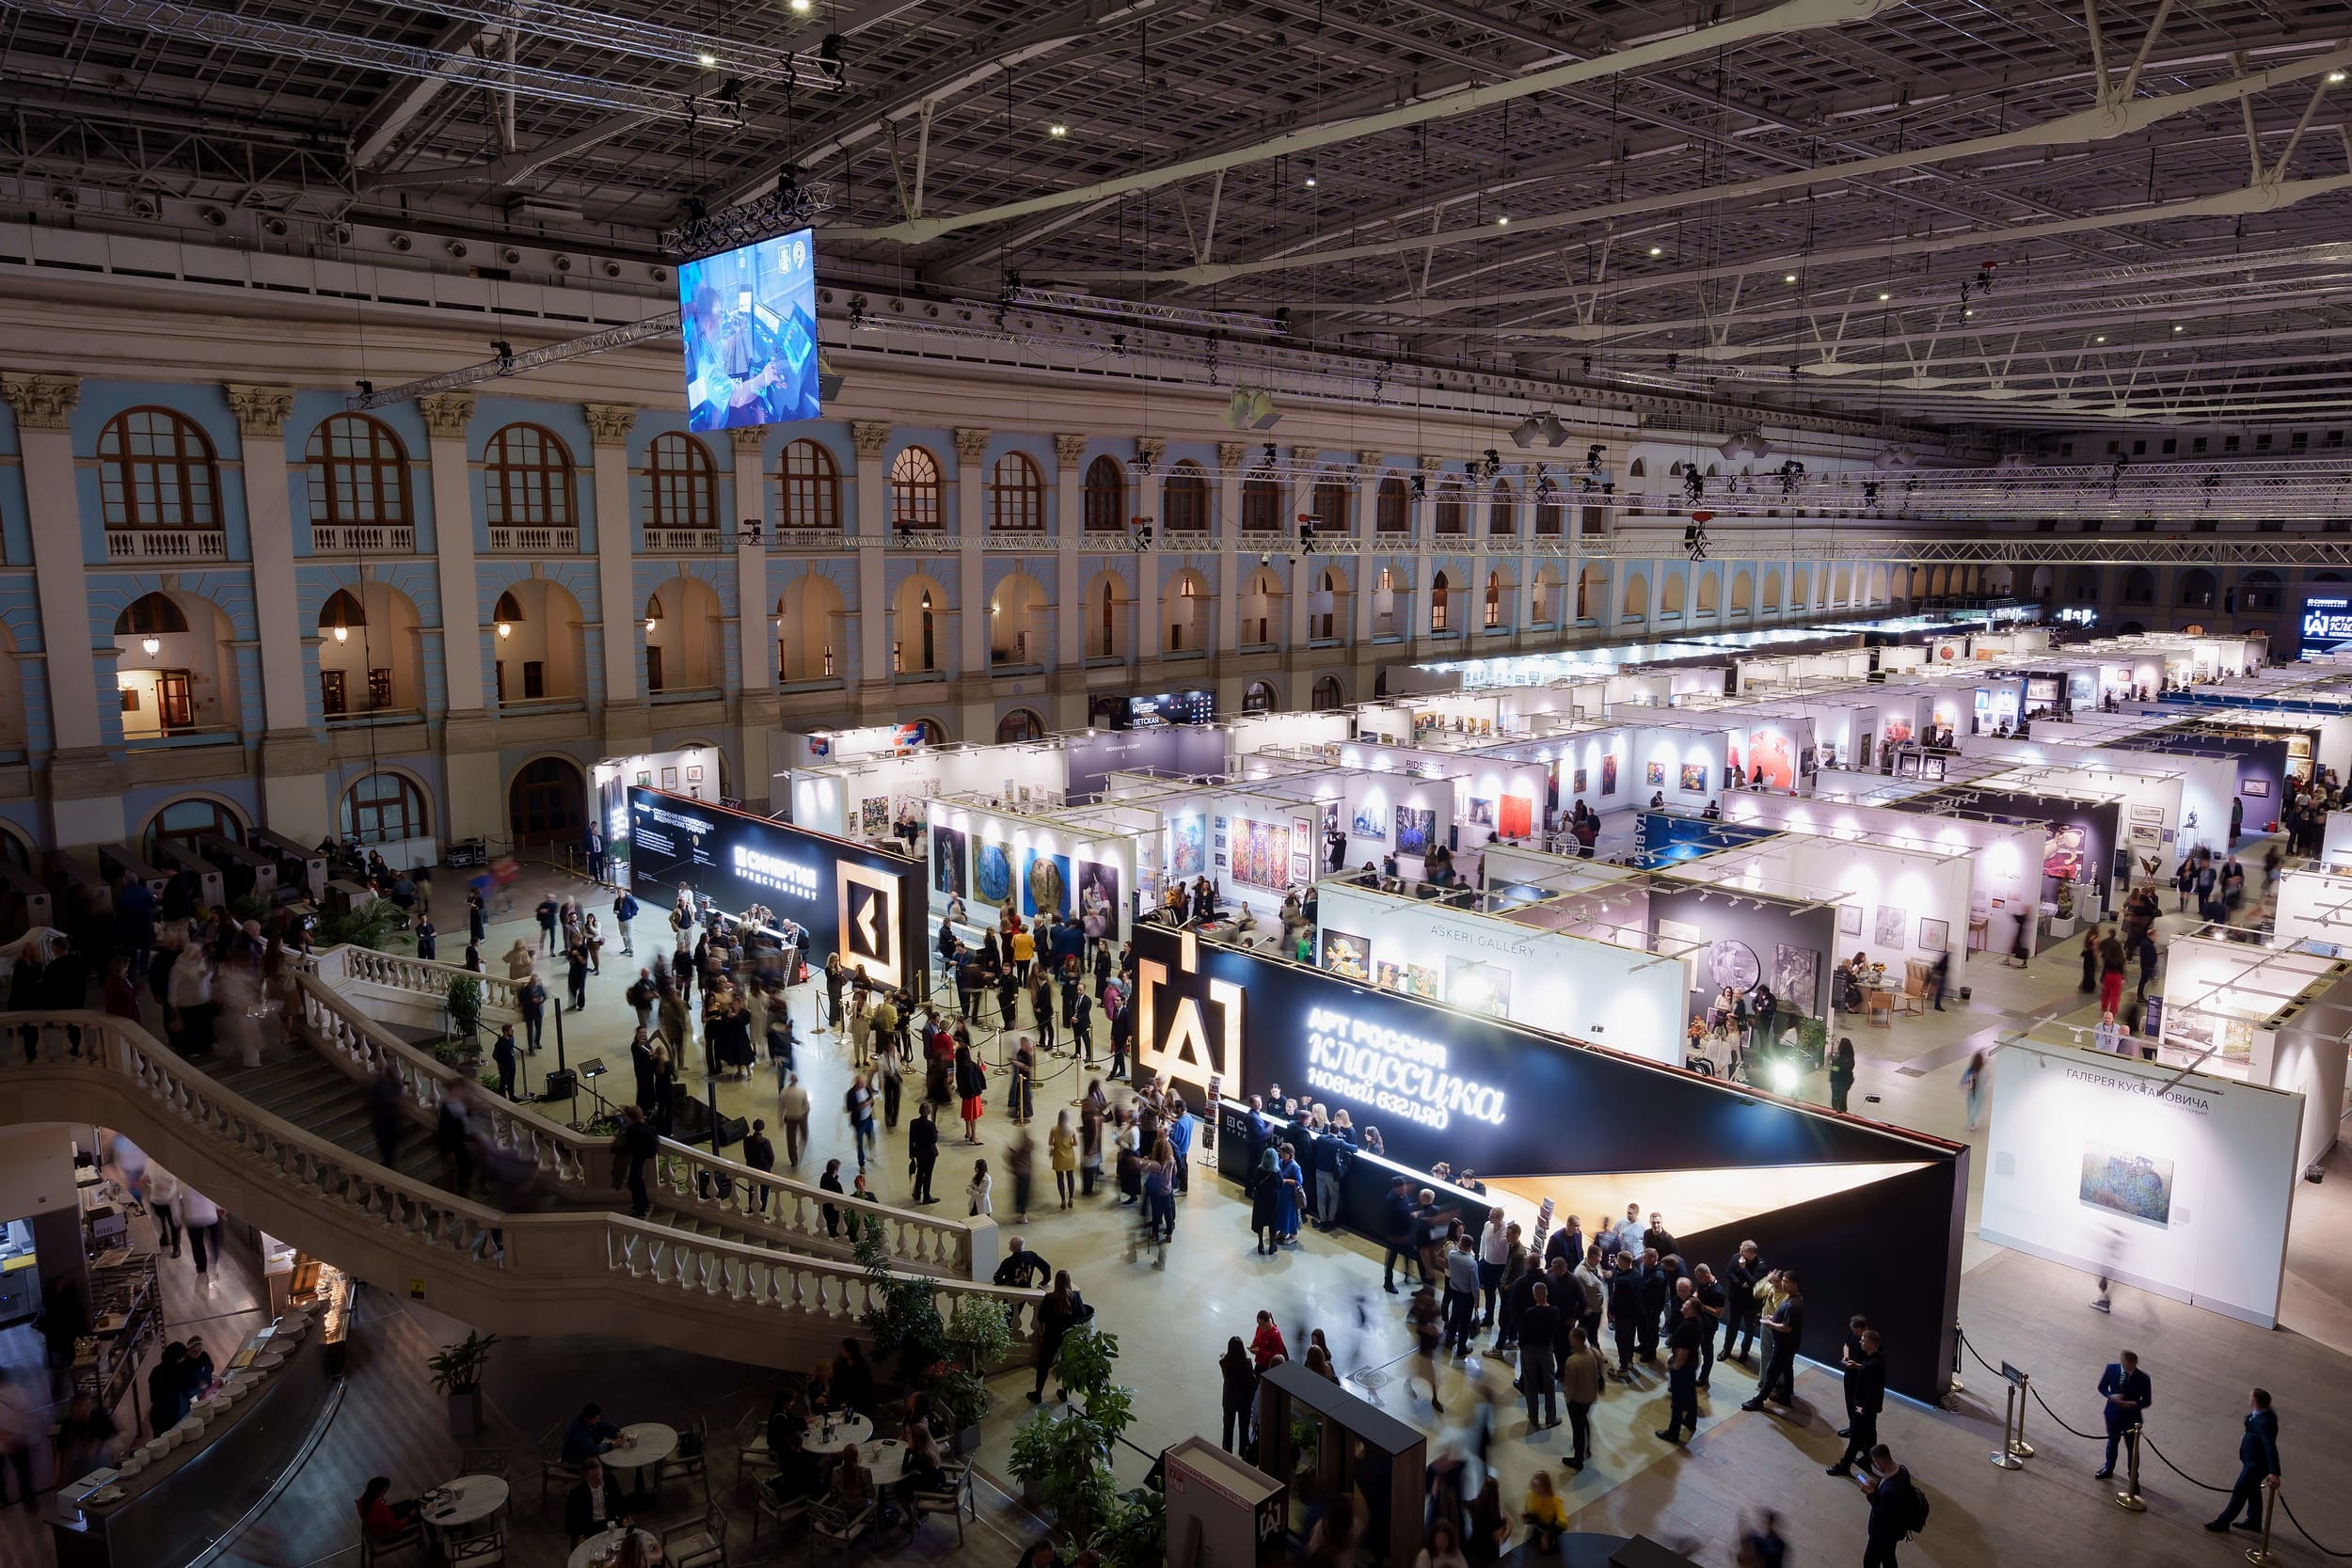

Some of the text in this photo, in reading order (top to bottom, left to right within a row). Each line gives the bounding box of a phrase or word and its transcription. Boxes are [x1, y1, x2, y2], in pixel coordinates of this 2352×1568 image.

[1431, 925, 1534, 957] ASKERI GALLERY
[1309, 1008, 1447, 1069] АРТ РОССИЯ
[2066, 1069, 2116, 1088] ГАЛЕРЕЯ
